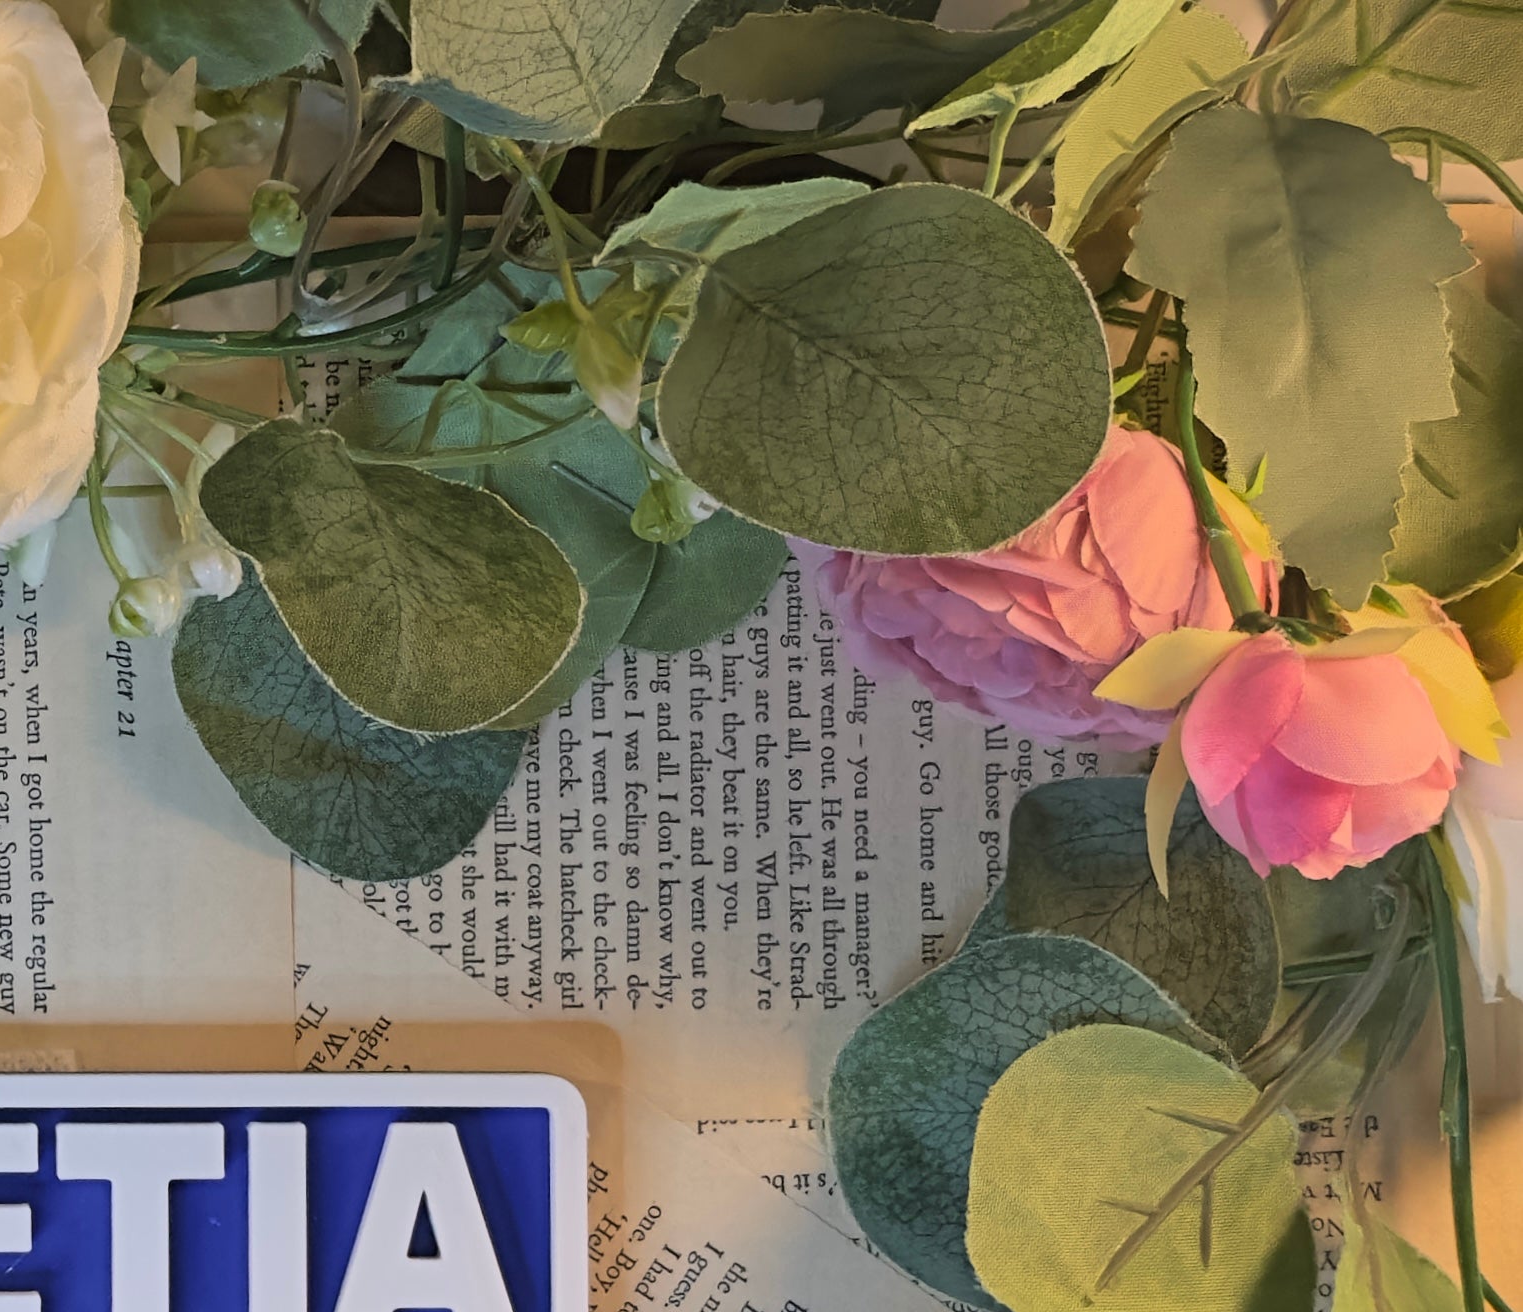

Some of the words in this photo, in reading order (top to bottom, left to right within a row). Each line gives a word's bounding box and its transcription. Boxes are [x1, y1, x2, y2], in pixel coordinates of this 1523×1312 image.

[16, 611, 39, 674] years,
[746, 626, 770, 679] guys
[812, 633, 841, 677] just
[688, 648, 713, 684] off
[25, 683, 49, 745] when
[117, 710, 136, 737] 21
[689, 687, 713, 722] the
[755, 689, 770, 723] are
[820, 682, 838, 740] went
[910, 698, 936, 751] guy.
[27, 754, 48, 763] I
[558, 728, 583, 798] check.
[755, 733, 778, 768] the
[820, 746, 838, 790] out.
[20, 772, 45, 810] got
[526, 778, 541, 814] me
[689, 730, 713, 818] radiator
[919, 761, 941, 796] Go
[755, 777, 771, 839] same.
[821, 796, 843, 831] He
[29, 817, 52, 882] home
[519, 819, 542, 858] my
[559, 808, 583, 855] The
[690, 826, 714, 867] and
[919, 806, 944, 871] home
[821, 837, 837, 879] was
[526, 863, 545, 910] coat
[690, 875, 708, 933] went
[755, 850, 780, 921] When
[822, 885, 846, 912] all
[920, 881, 945, 922] and
[31, 890, 55, 926] the
[560, 863, 584, 962] hatcheck
[25, 934, 56, 1014] regular
[520, 914, 543, 1009] anyway.
[691, 941, 708, 979] out
[815, 919, 847, 1010] through
[553, 971, 585, 1011] girl
[691, 987, 708, 1010] to
